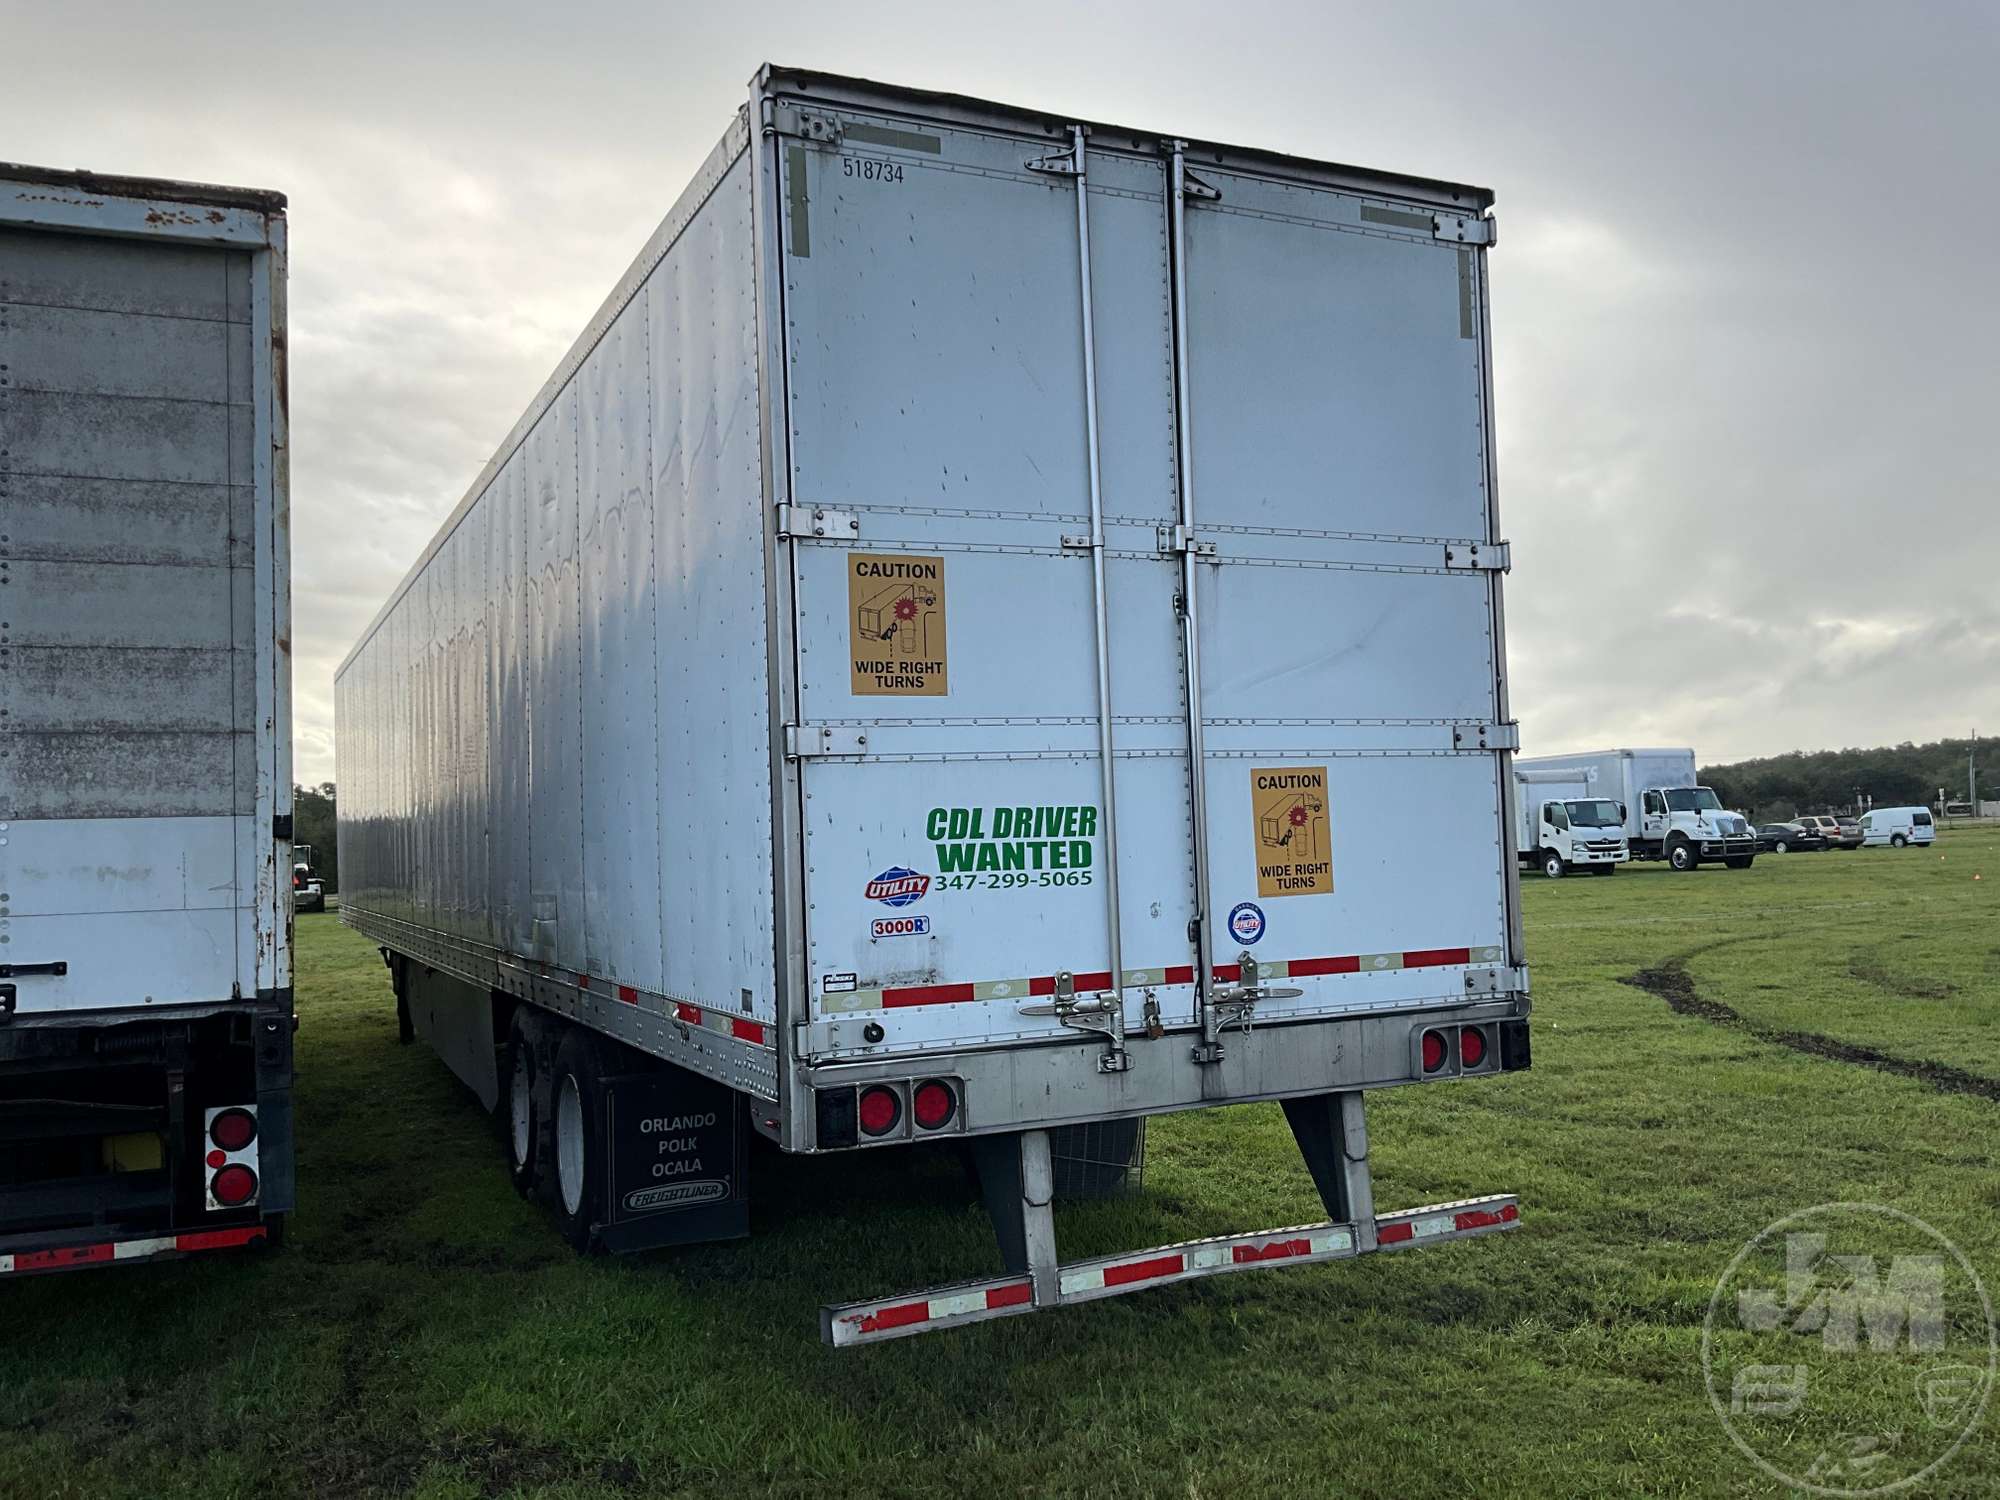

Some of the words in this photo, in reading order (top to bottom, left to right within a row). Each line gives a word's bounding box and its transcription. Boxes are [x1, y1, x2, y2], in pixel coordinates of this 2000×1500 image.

[843, 157, 904, 184] 518734
[856, 562, 937, 579] CAUTION
[855, 661, 894, 674] WIDE
[899, 661, 943, 675] RIGHT
[874, 675, 924, 688] TURNS
[1257, 774, 1321, 790] CAUTION
[926, 807, 985, 841] CDL
[991, 806, 1098, 839] DRIVER
[935, 840, 1093, 873] WANTED
[1260, 864, 1291, 878] WIDE
[1295, 862, 1329, 875] RIGHT
[869, 879, 926, 897] UTILITY
[934, 871, 1093, 892] 347-299-5065
[1276, 876, 1316, 890] TURNS
[639, 1112, 716, 1134] ORLANDO
[658, 1136, 698, 1154] POLK
[651, 1158, 703, 1177] OCALA
[634, 1185, 720, 1206] FREIGHTLINER
